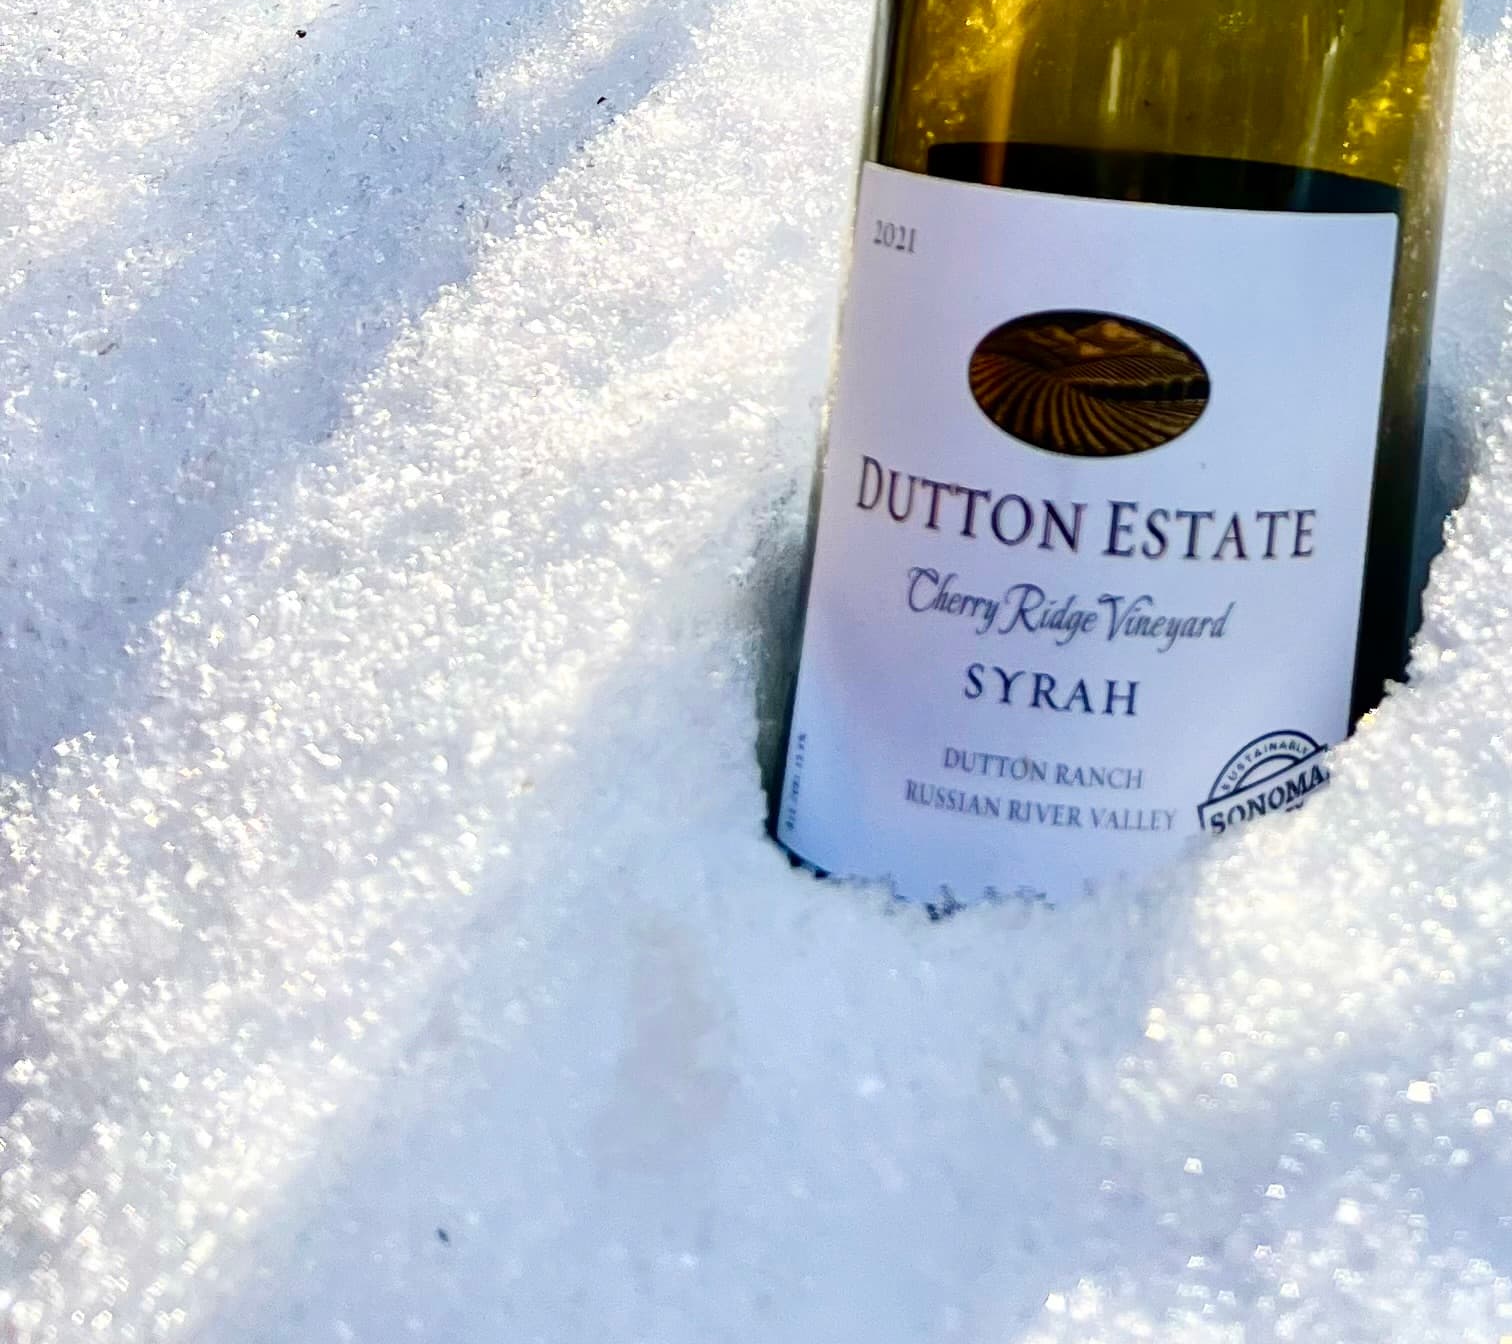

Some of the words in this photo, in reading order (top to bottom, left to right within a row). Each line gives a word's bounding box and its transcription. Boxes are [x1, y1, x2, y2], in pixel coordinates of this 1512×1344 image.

[873, 220, 917, 255] 2021
[855, 454, 1089, 554] DUTTON
[1102, 500, 1318, 561] ESTATE
[906, 566, 1002, 635] Cherry
[998, 583, 1099, 647] Ridge
[1097, 593, 1237, 653] Vineyard
[963, 663, 1141, 717] SYRAH
[943, 747, 1048, 782] DUTTON
[1054, 764, 1144, 790] RANCH
[905, 779, 1001, 818] RUSSIAN
[1007, 799, 1083, 828] RIVER
[1090, 808, 1178, 832] VALLEY
[1209, 763, 1324, 834] SONOMA
